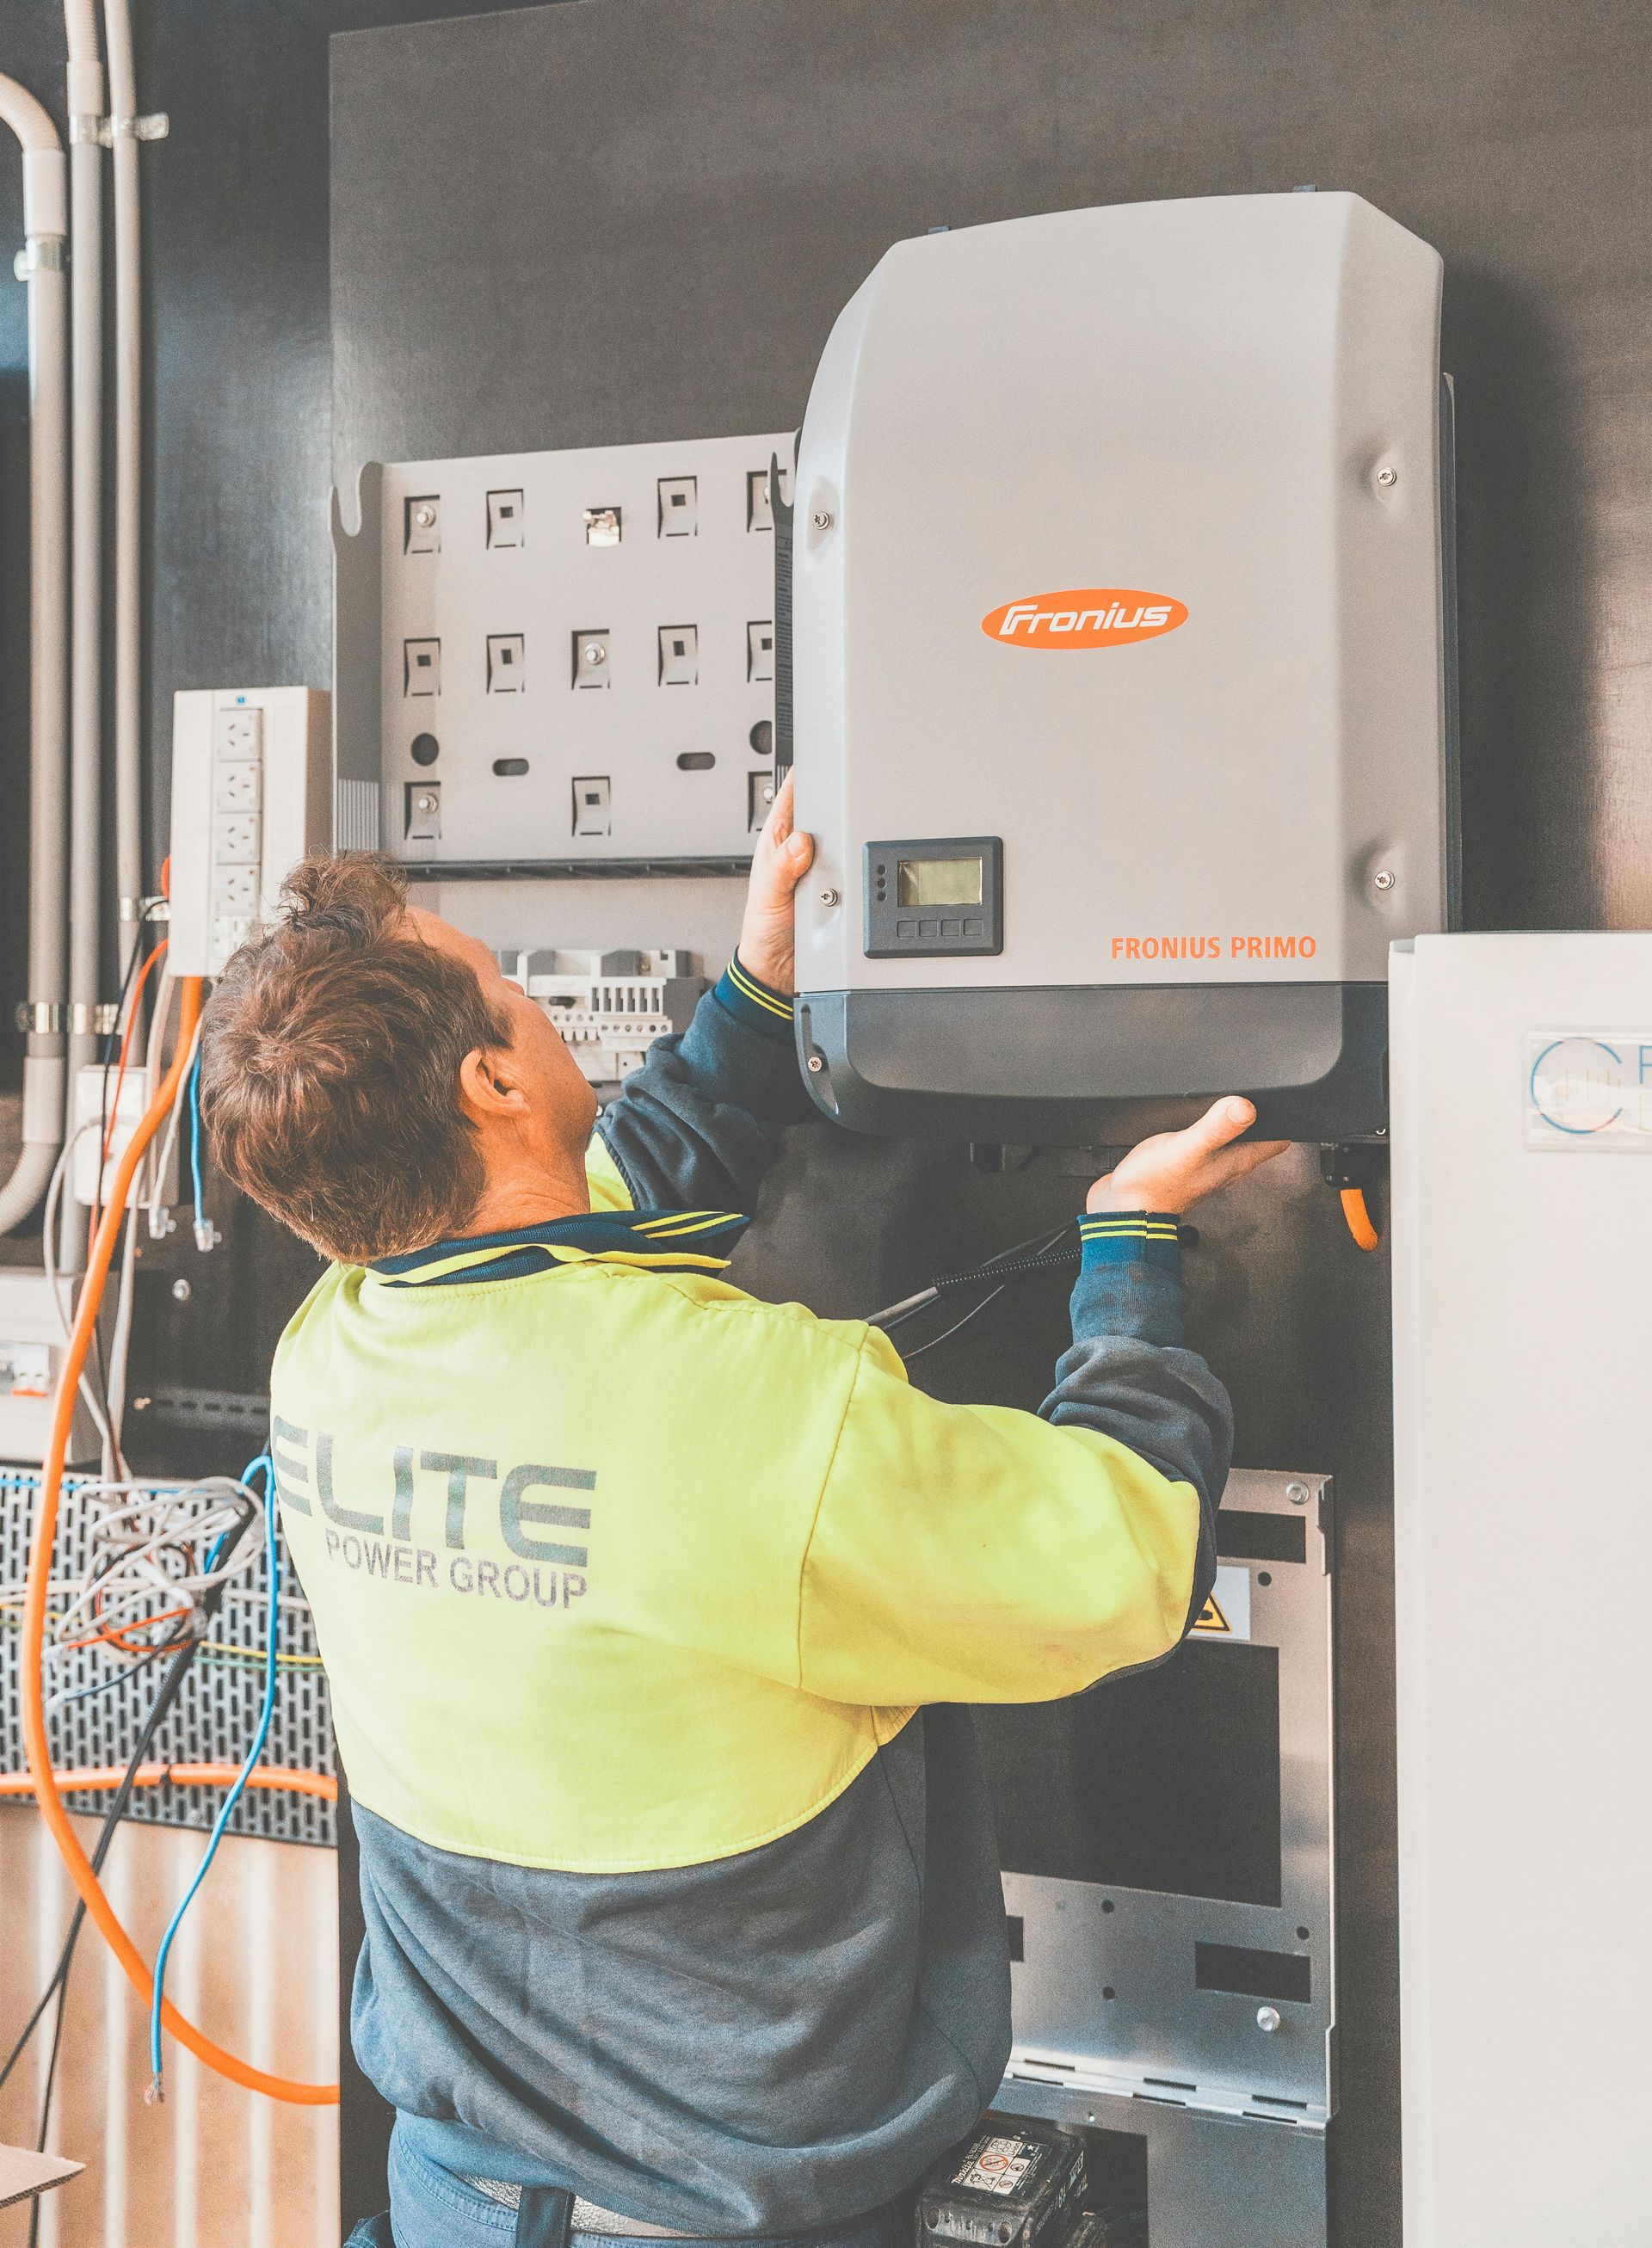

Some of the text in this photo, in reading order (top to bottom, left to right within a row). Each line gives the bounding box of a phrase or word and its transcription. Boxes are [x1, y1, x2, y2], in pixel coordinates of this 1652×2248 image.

[999, 602, 1172, 635] Fronius
[1112, 935, 1316, 959] FRONIUS PRIMO
[271, 1415, 597, 1567] ELITE
[325, 1527, 588, 1608] POWER GROUP
